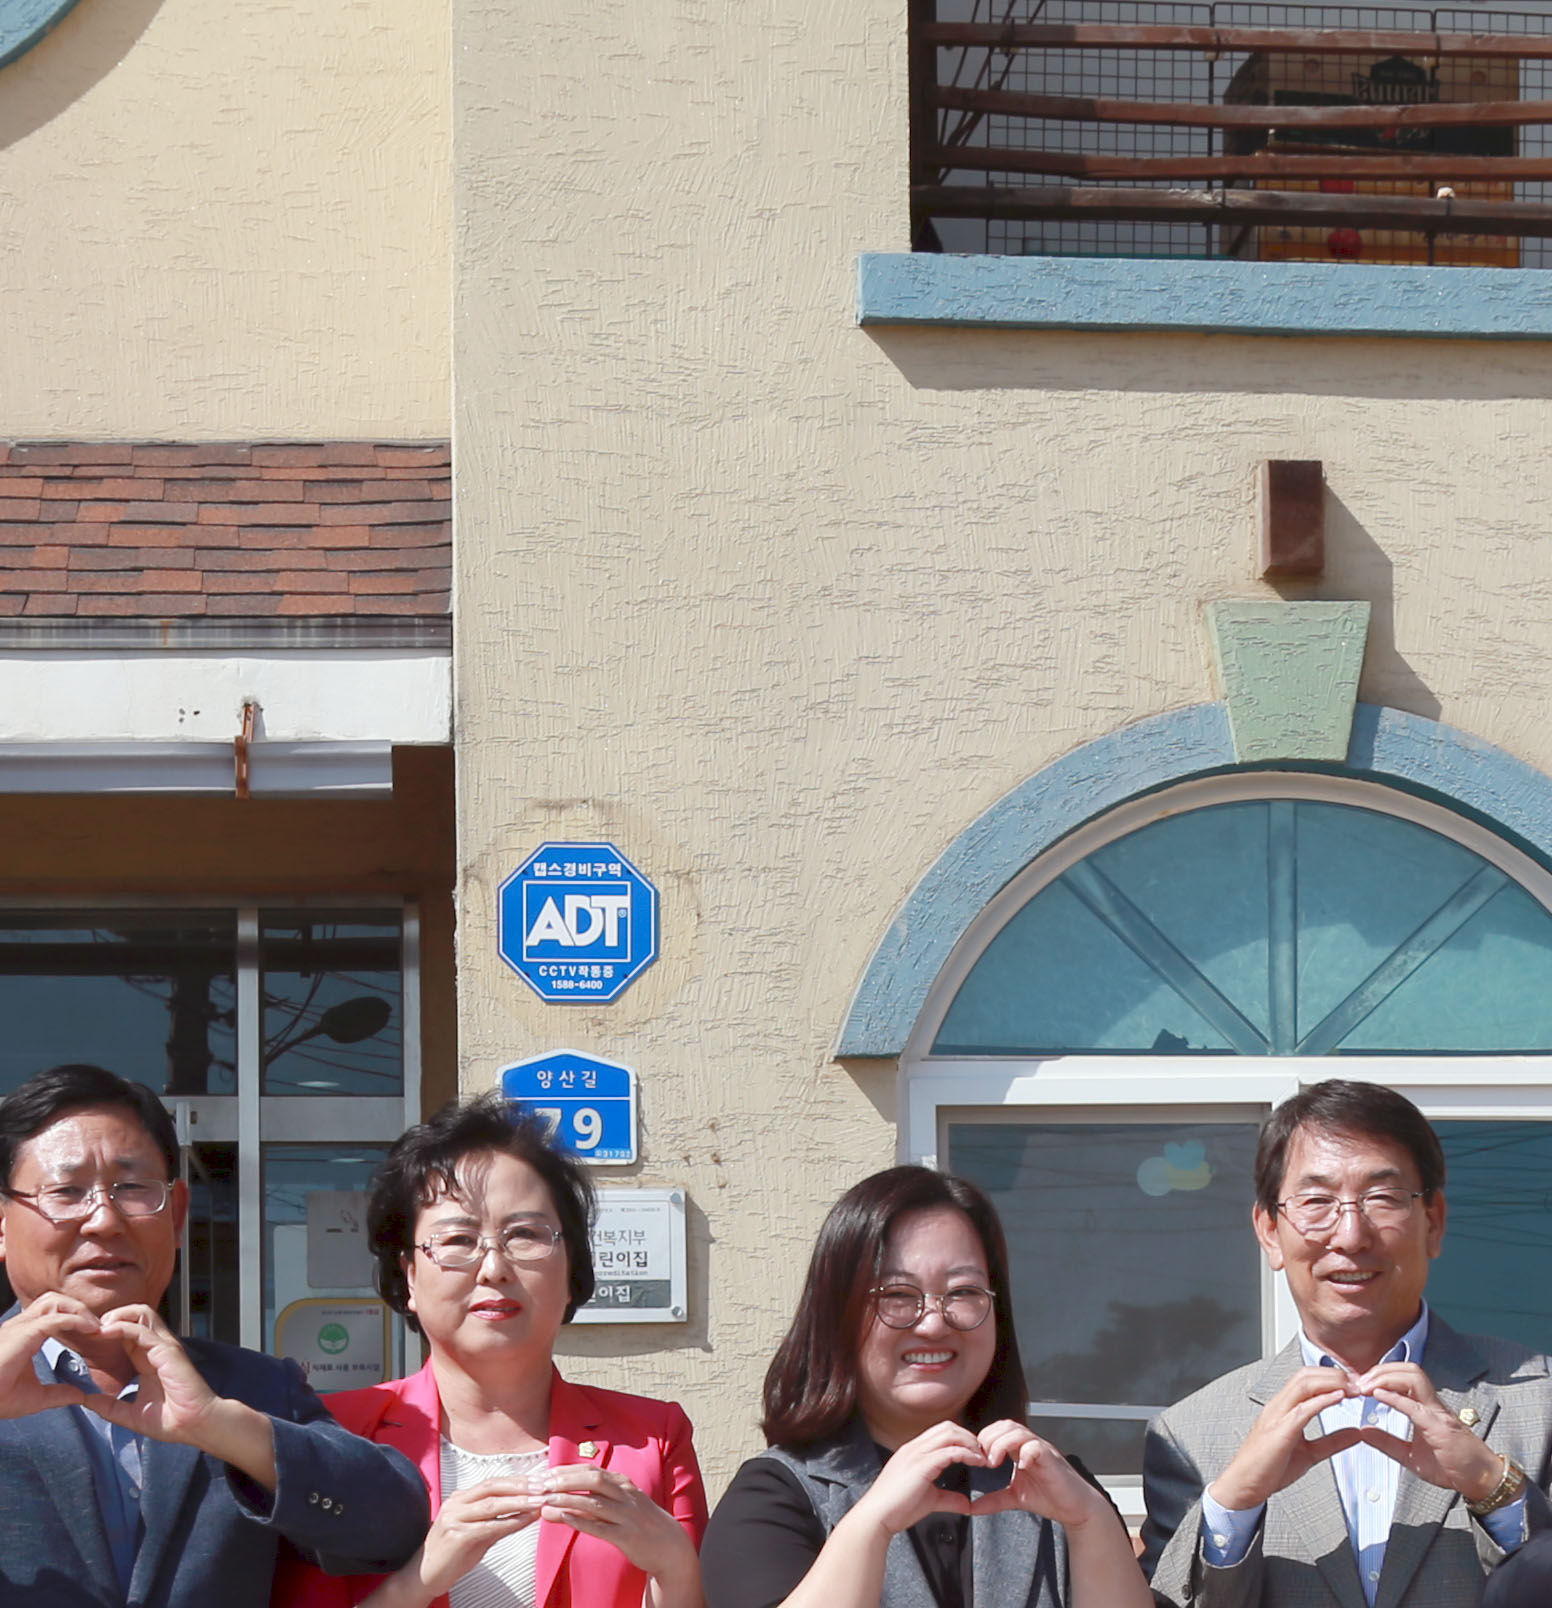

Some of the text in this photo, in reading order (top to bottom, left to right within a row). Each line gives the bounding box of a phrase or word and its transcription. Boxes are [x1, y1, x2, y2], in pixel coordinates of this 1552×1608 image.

[533, 862, 622, 877] 캡스경비구역
[525, 894, 629, 947] ADT
[538, 965, 614, 978] CCTV작동중
[551, 980, 603, 990] 1588-6400
[536, 1070, 597, 1089] 양산길
[534, 1107, 603, 1150] 79
[592, 1251, 648, 1268] 린이집
[588, 1284, 631, 1303] 이집
